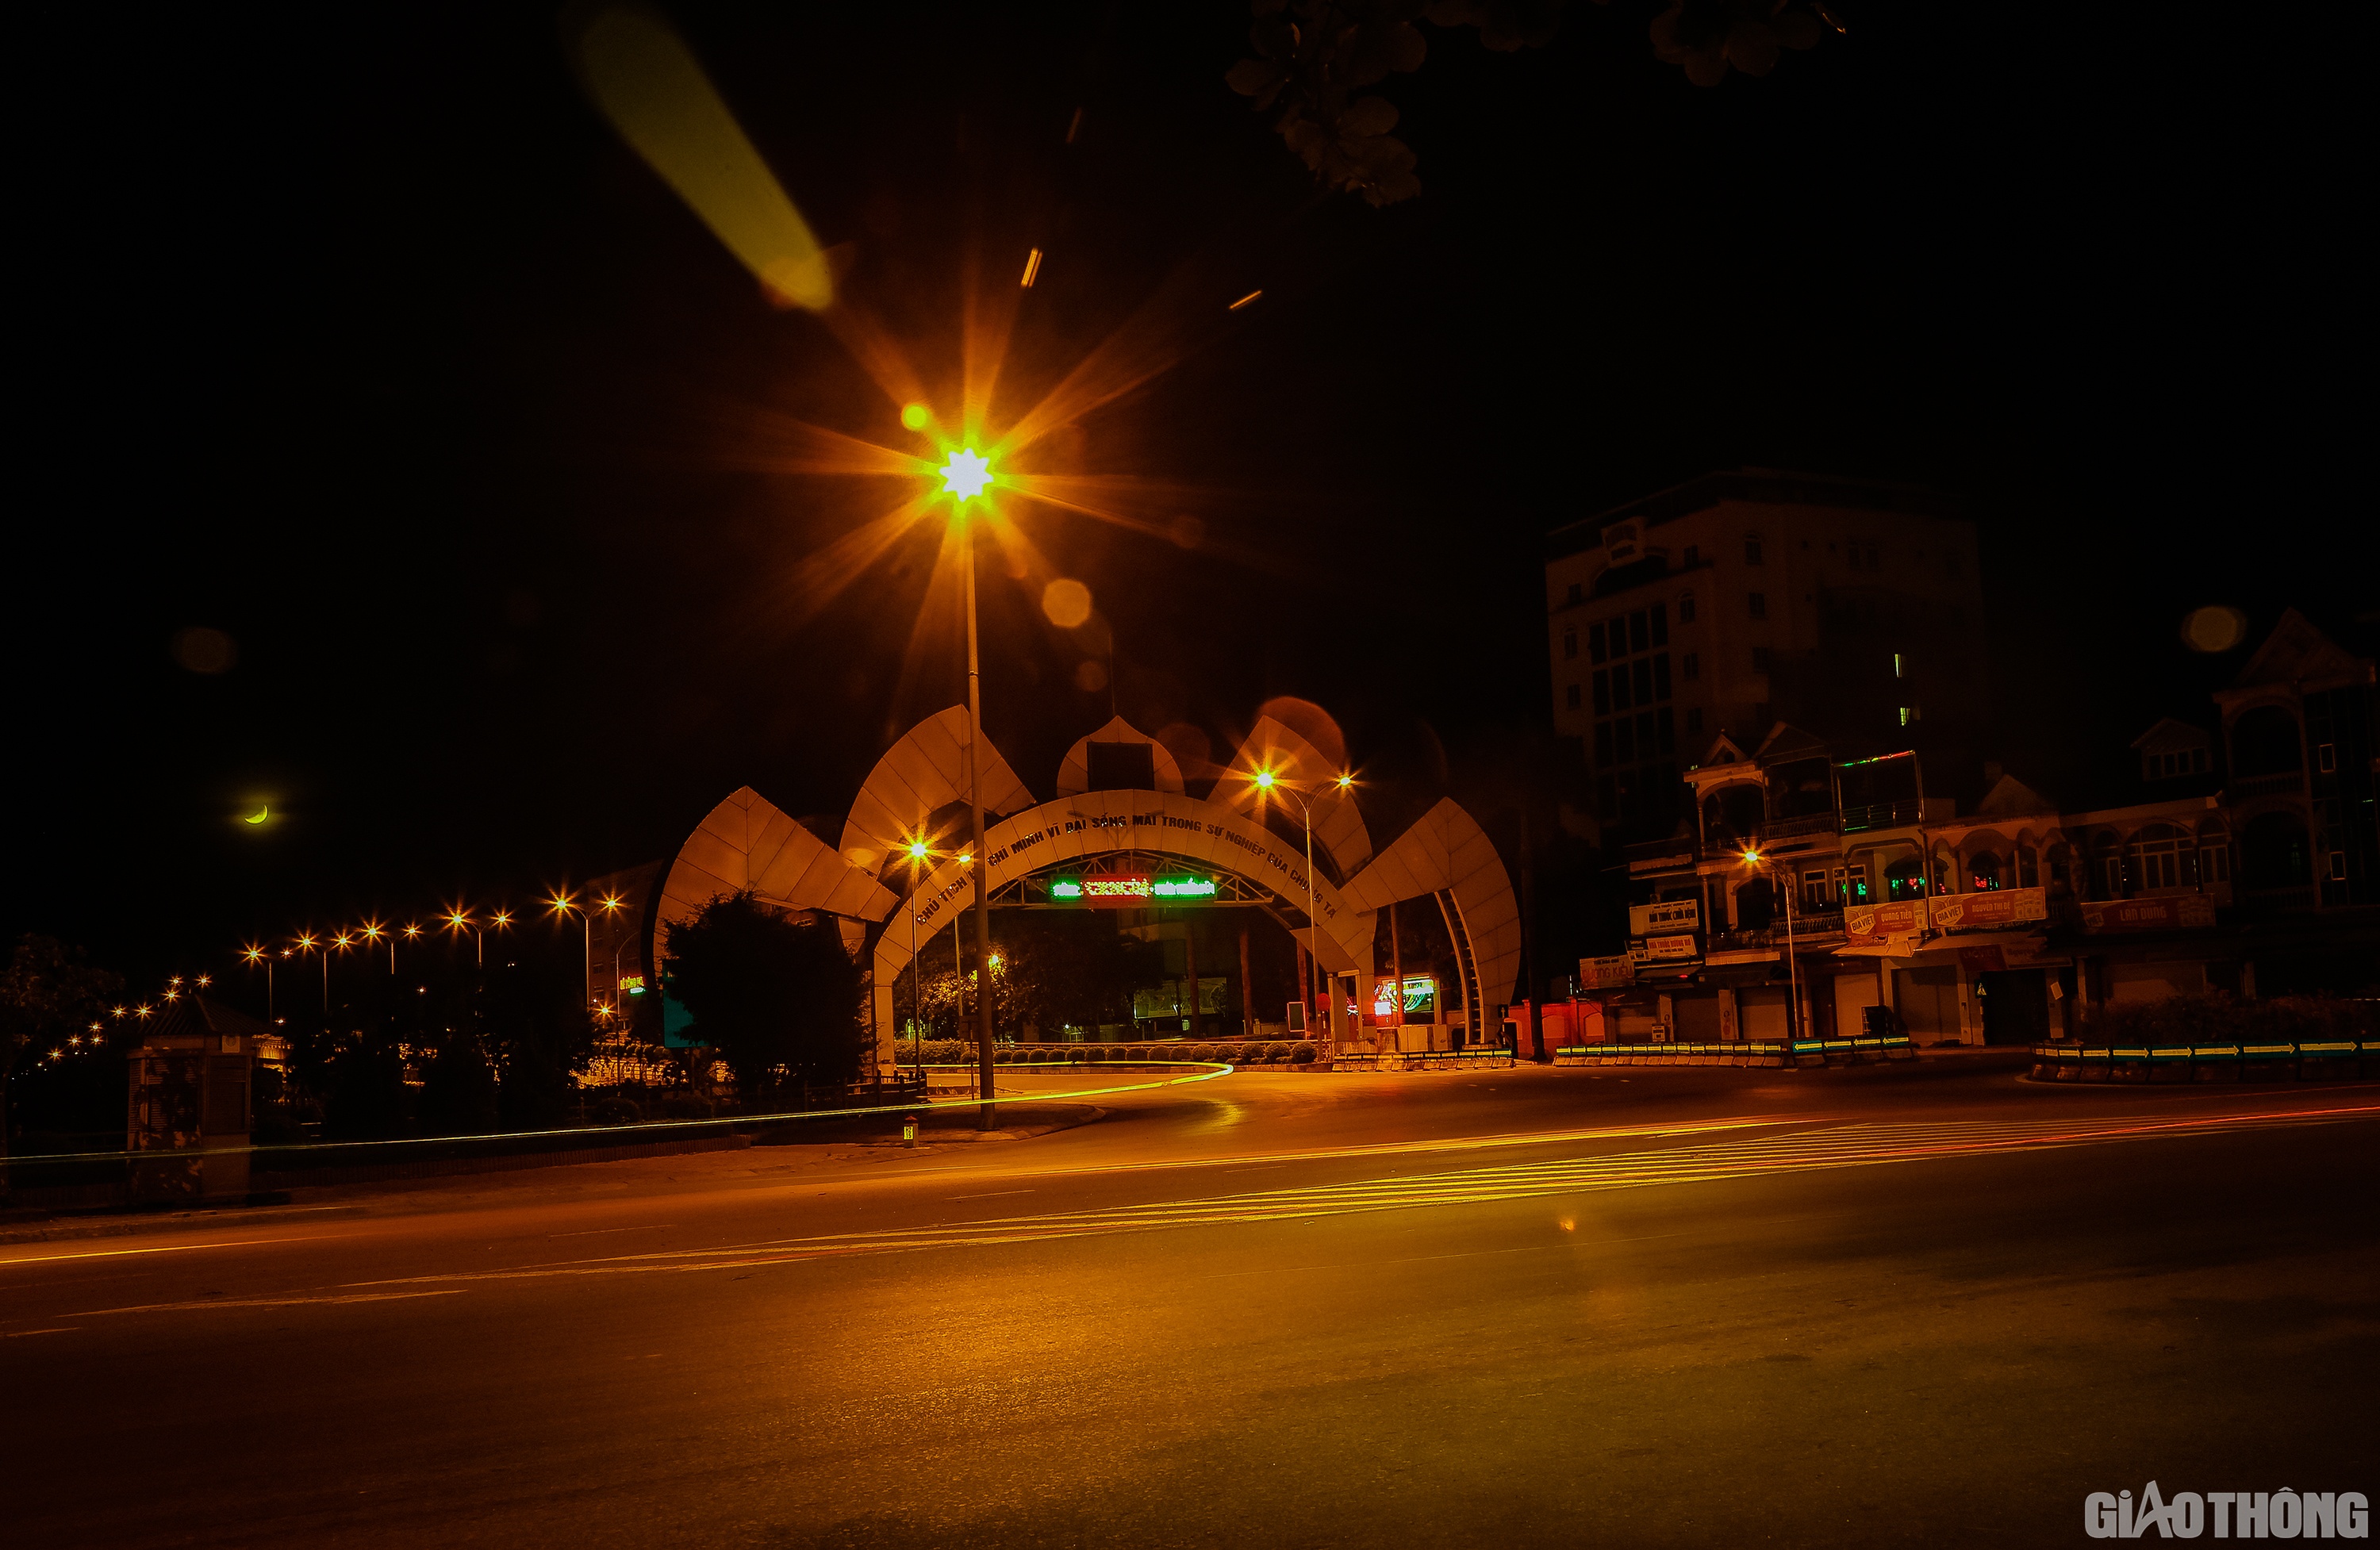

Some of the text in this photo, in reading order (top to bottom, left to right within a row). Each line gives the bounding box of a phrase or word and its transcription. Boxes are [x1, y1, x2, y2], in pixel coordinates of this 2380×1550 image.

[916, 898, 940, 926] CHỦ
[938, 877, 968, 903] TỊCH
[987, 846, 1009, 867] CHÍ
[1011, 831, 1044, 854] MINH
[1046, 823, 1061, 838] VĨ
[1065, 820, 1087, 834] ĐẠI
[1092, 812, 1127, 828] SỐNG
[1132, 812, 1157, 826] MÃI
[1162, 816, 1202, 832] TRONG
[1206, 823, 1225, 839] SỰ
[1225, 830, 1266, 857] NGHIỆP
[1267, 852, 1288, 874] CỦA
[1323, 901, 1336, 919] TA
[1852, 914, 1874, 930] BIA VIỆT
[1881, 911, 1899, 923] QUANG
[1937, 906, 1962, 923] BIA VIỆT
[2120, 908, 2138, 922] LAN
